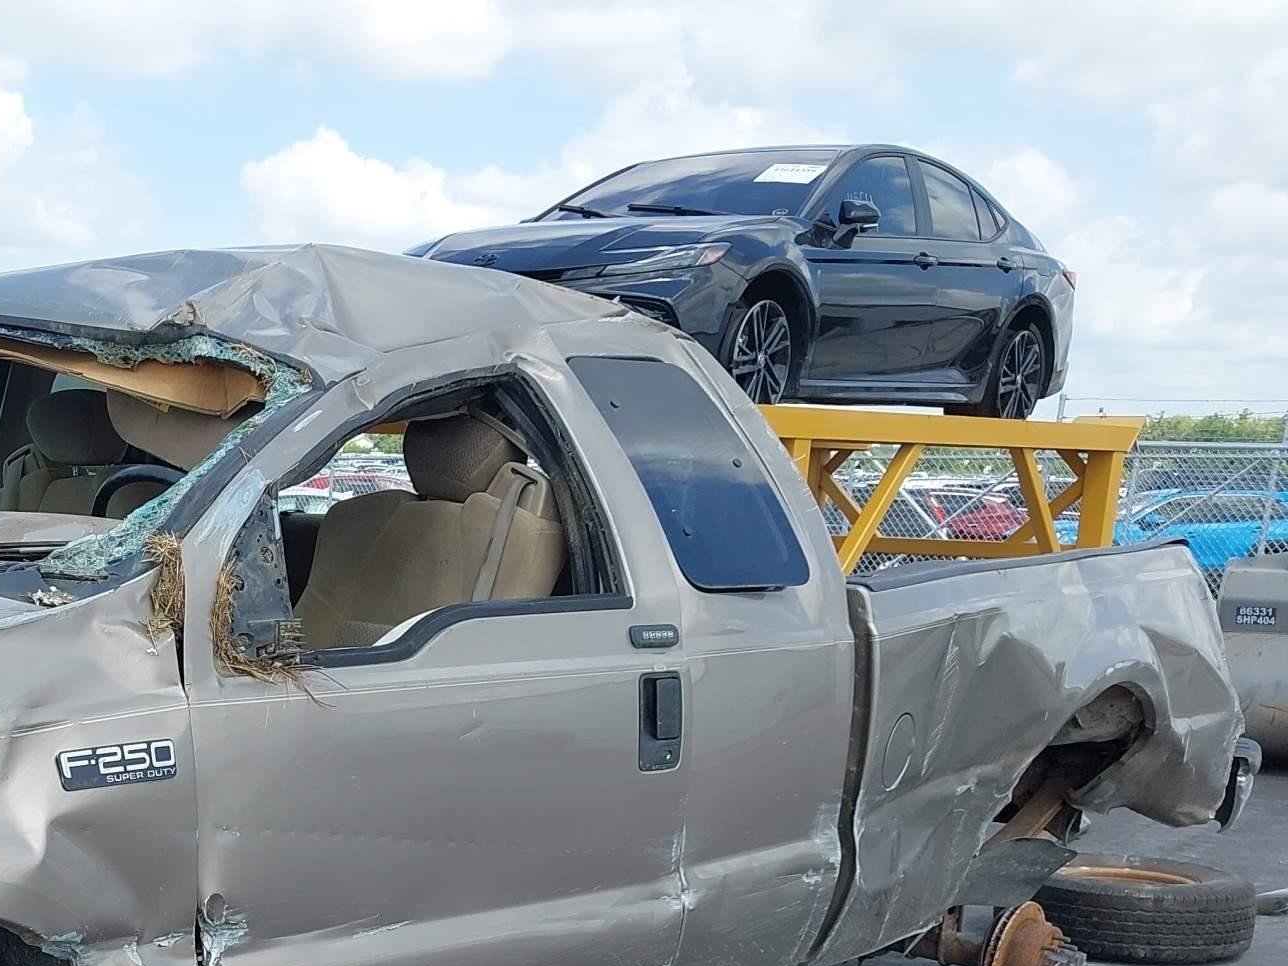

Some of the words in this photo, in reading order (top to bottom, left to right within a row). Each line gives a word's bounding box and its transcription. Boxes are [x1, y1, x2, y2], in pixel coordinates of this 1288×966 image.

[1239, 607, 1273, 616] 86331
[1236, 615, 1275, 625] SHP404
[106, 771, 144, 783] SUPER
[147, 767, 176, 778] DUTY
